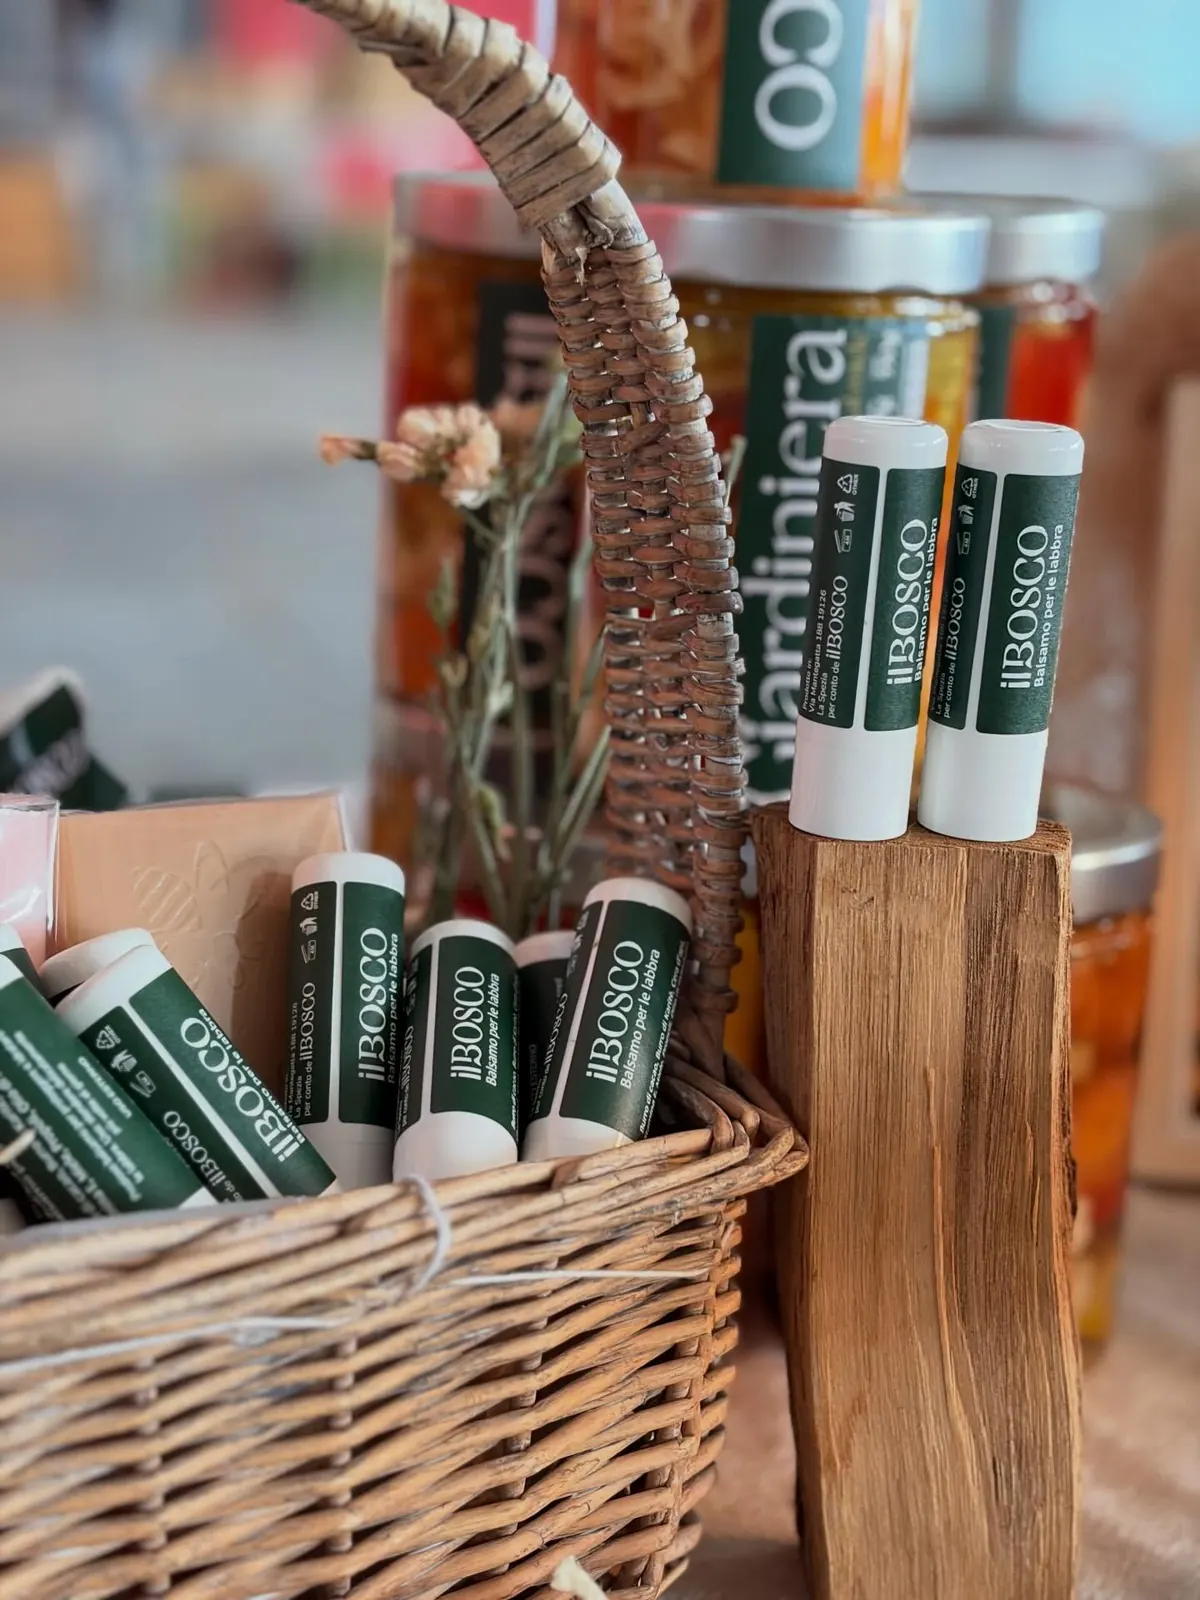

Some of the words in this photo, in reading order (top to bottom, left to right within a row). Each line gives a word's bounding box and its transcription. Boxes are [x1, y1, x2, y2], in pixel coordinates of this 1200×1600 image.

[925, 516, 938, 567] labbra
[1047, 523, 1063, 573] labbra
[923, 569, 932, 584] le
[1045, 576, 1057, 591] le
[817, 589, 826, 619] 19126
[887, 519, 927, 685] ilBOSCO
[921, 586, 931, 612] per
[1000, 525, 1048, 689] ilBOSCO
[1042, 592, 1054, 618] per
[815, 622, 823, 640] 188
[825, 575, 848, 660] ilBOSCO
[913, 615, 928, 682] Balsamo
[1033, 621, 1051, 687] Balsamo
[810, 643, 822, 695] Mantegatta
[830, 661, 840, 673] de
[946, 661, 955, 673] de
[817, 672, 828, 702] Spezia
[828, 675, 838, 700] conto
[944, 675, 954, 700] conto
[808, 698, 816, 712] Via
[816, 704, 825, 715] La
[827, 702, 835, 718] per
[943, 702, 952, 718] per
[389, 932, 398, 977] labbra
[642, 948, 661, 990] labbra
[388, 980, 397, 993] le
[487, 972, 500, 1007] labbra
[638, 992, 651, 1004] le
[358, 928, 388, 1082] ilBOSCO
[389, 994, 398, 1019] per
[487, 1007, 498, 1018] le
[586, 940, 644, 1083] ilBOSCO
[634, 1007, 648, 1030] per
[196, 1006, 233, 1050] labbra
[299, 982, 316, 1060] ilBOSCO
[450, 966, 485, 1081] ilBOSCO
[489, 1017, 499, 1039] per
[229, 1049, 244, 1064] le
[654, 1031, 665, 1059] Burro
[304, 1061, 312, 1072] de
[485, 1038, 498, 1085] Balsamo
[619, 1030, 643, 1089] Balsamo
[241, 1062, 262, 1087] per
[303, 1074, 311, 1099] conto
[181, 1017, 300, 1162] ilBOSCO
[643, 1092, 653, 1105] di
[258, 1085, 306, 1144] Balsamo
[303, 1101, 311, 1116] per
[639, 1105, 649, 1133] Burro
[163, 1110, 226, 1187] ilBOSCO
